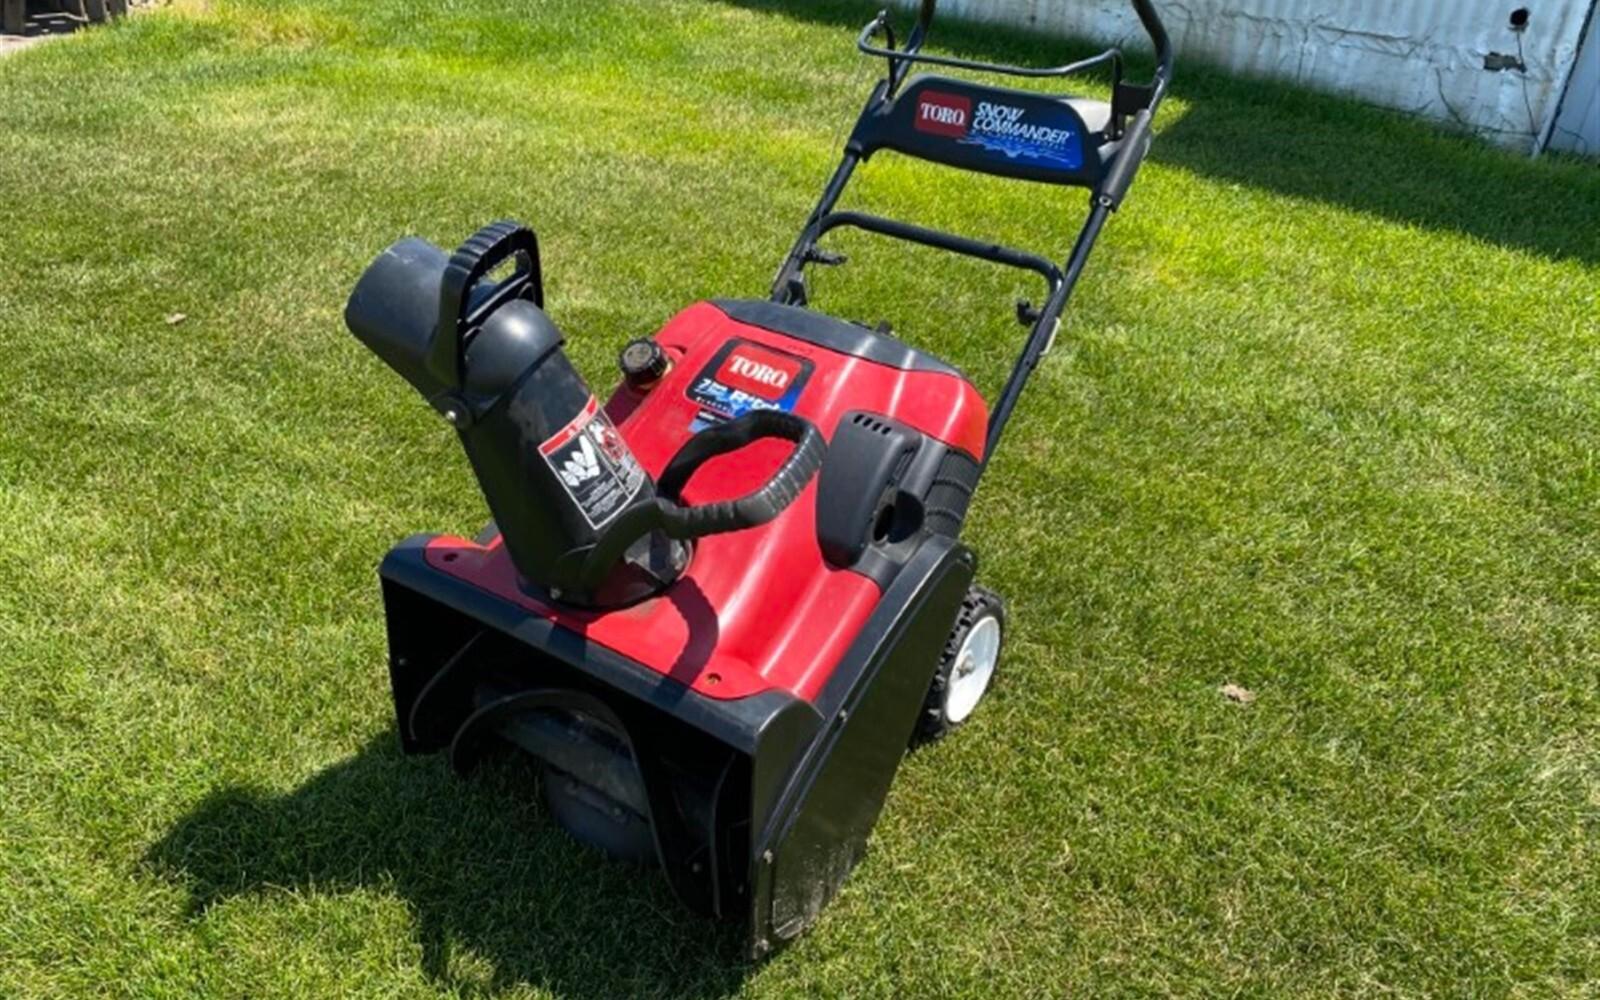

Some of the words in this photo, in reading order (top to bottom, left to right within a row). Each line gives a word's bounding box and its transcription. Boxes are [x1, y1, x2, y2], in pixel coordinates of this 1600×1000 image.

[920, 102, 965, 126] TORO
[974, 101, 1025, 121] SNOW
[972, 116, 1071, 144] COMMANDER
[729, 354, 788, 389] TORO
